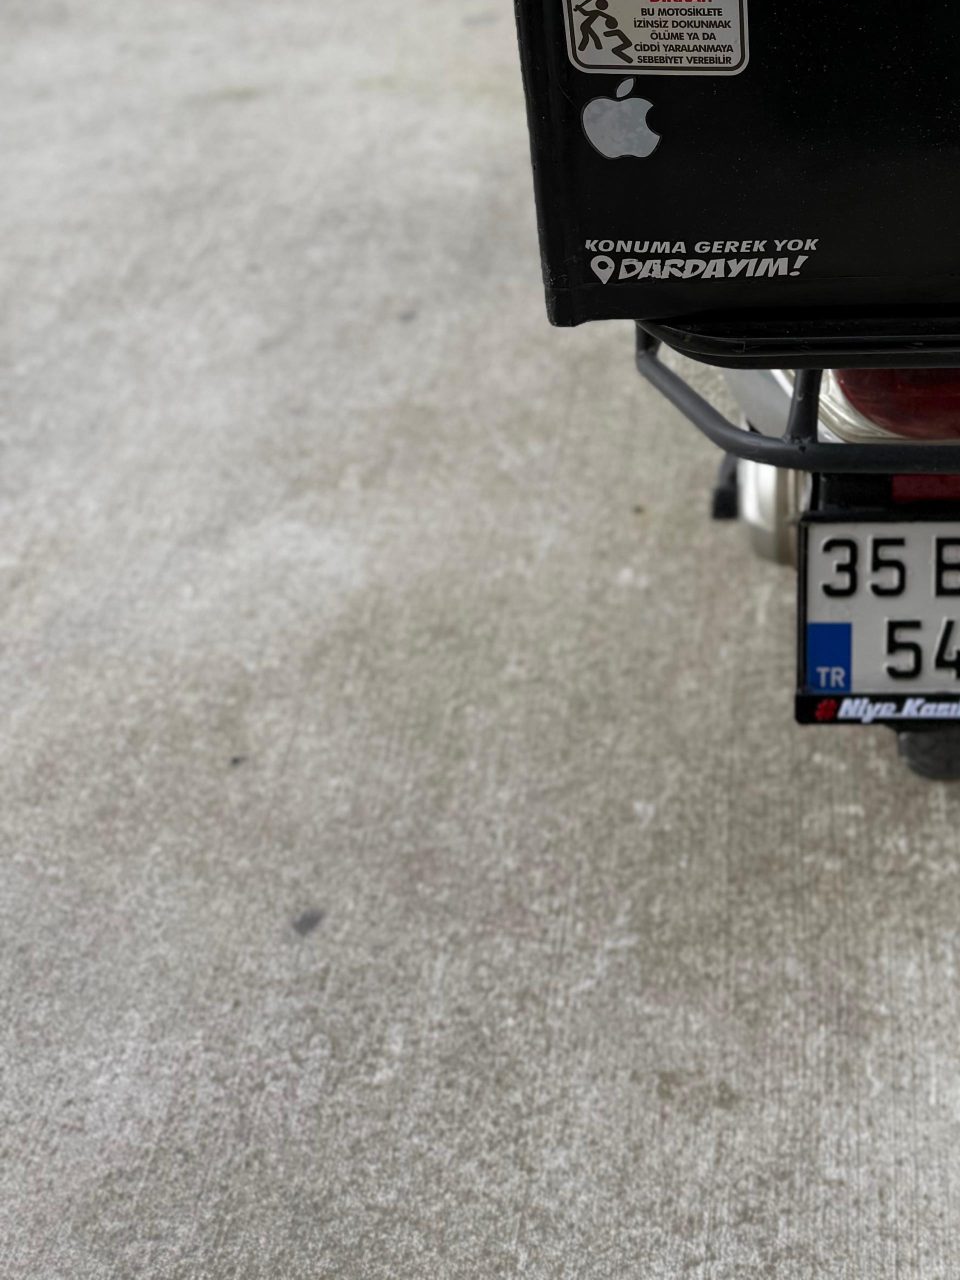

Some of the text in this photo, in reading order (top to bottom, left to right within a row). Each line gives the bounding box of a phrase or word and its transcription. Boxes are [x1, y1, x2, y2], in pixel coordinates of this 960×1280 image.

[641, 6, 723, 17] BU MOTOSİKLETE
[633, 18, 731, 29] İZİNSİZ DOKUNMAK
[650, 30, 717, 41] ÖLÜME YA DA
[634, 42, 734, 53] CİDDİ YARALANMAYA
[637, 54, 732, 65] SEBEBİYET VEREBİLİR
[585, 238, 820, 254] KONUMA GEREK YOK
[618, 255, 809, 280] DARDAYIM!
[820, 537, 907, 598] 35
[816, 667, 845, 688] TR
